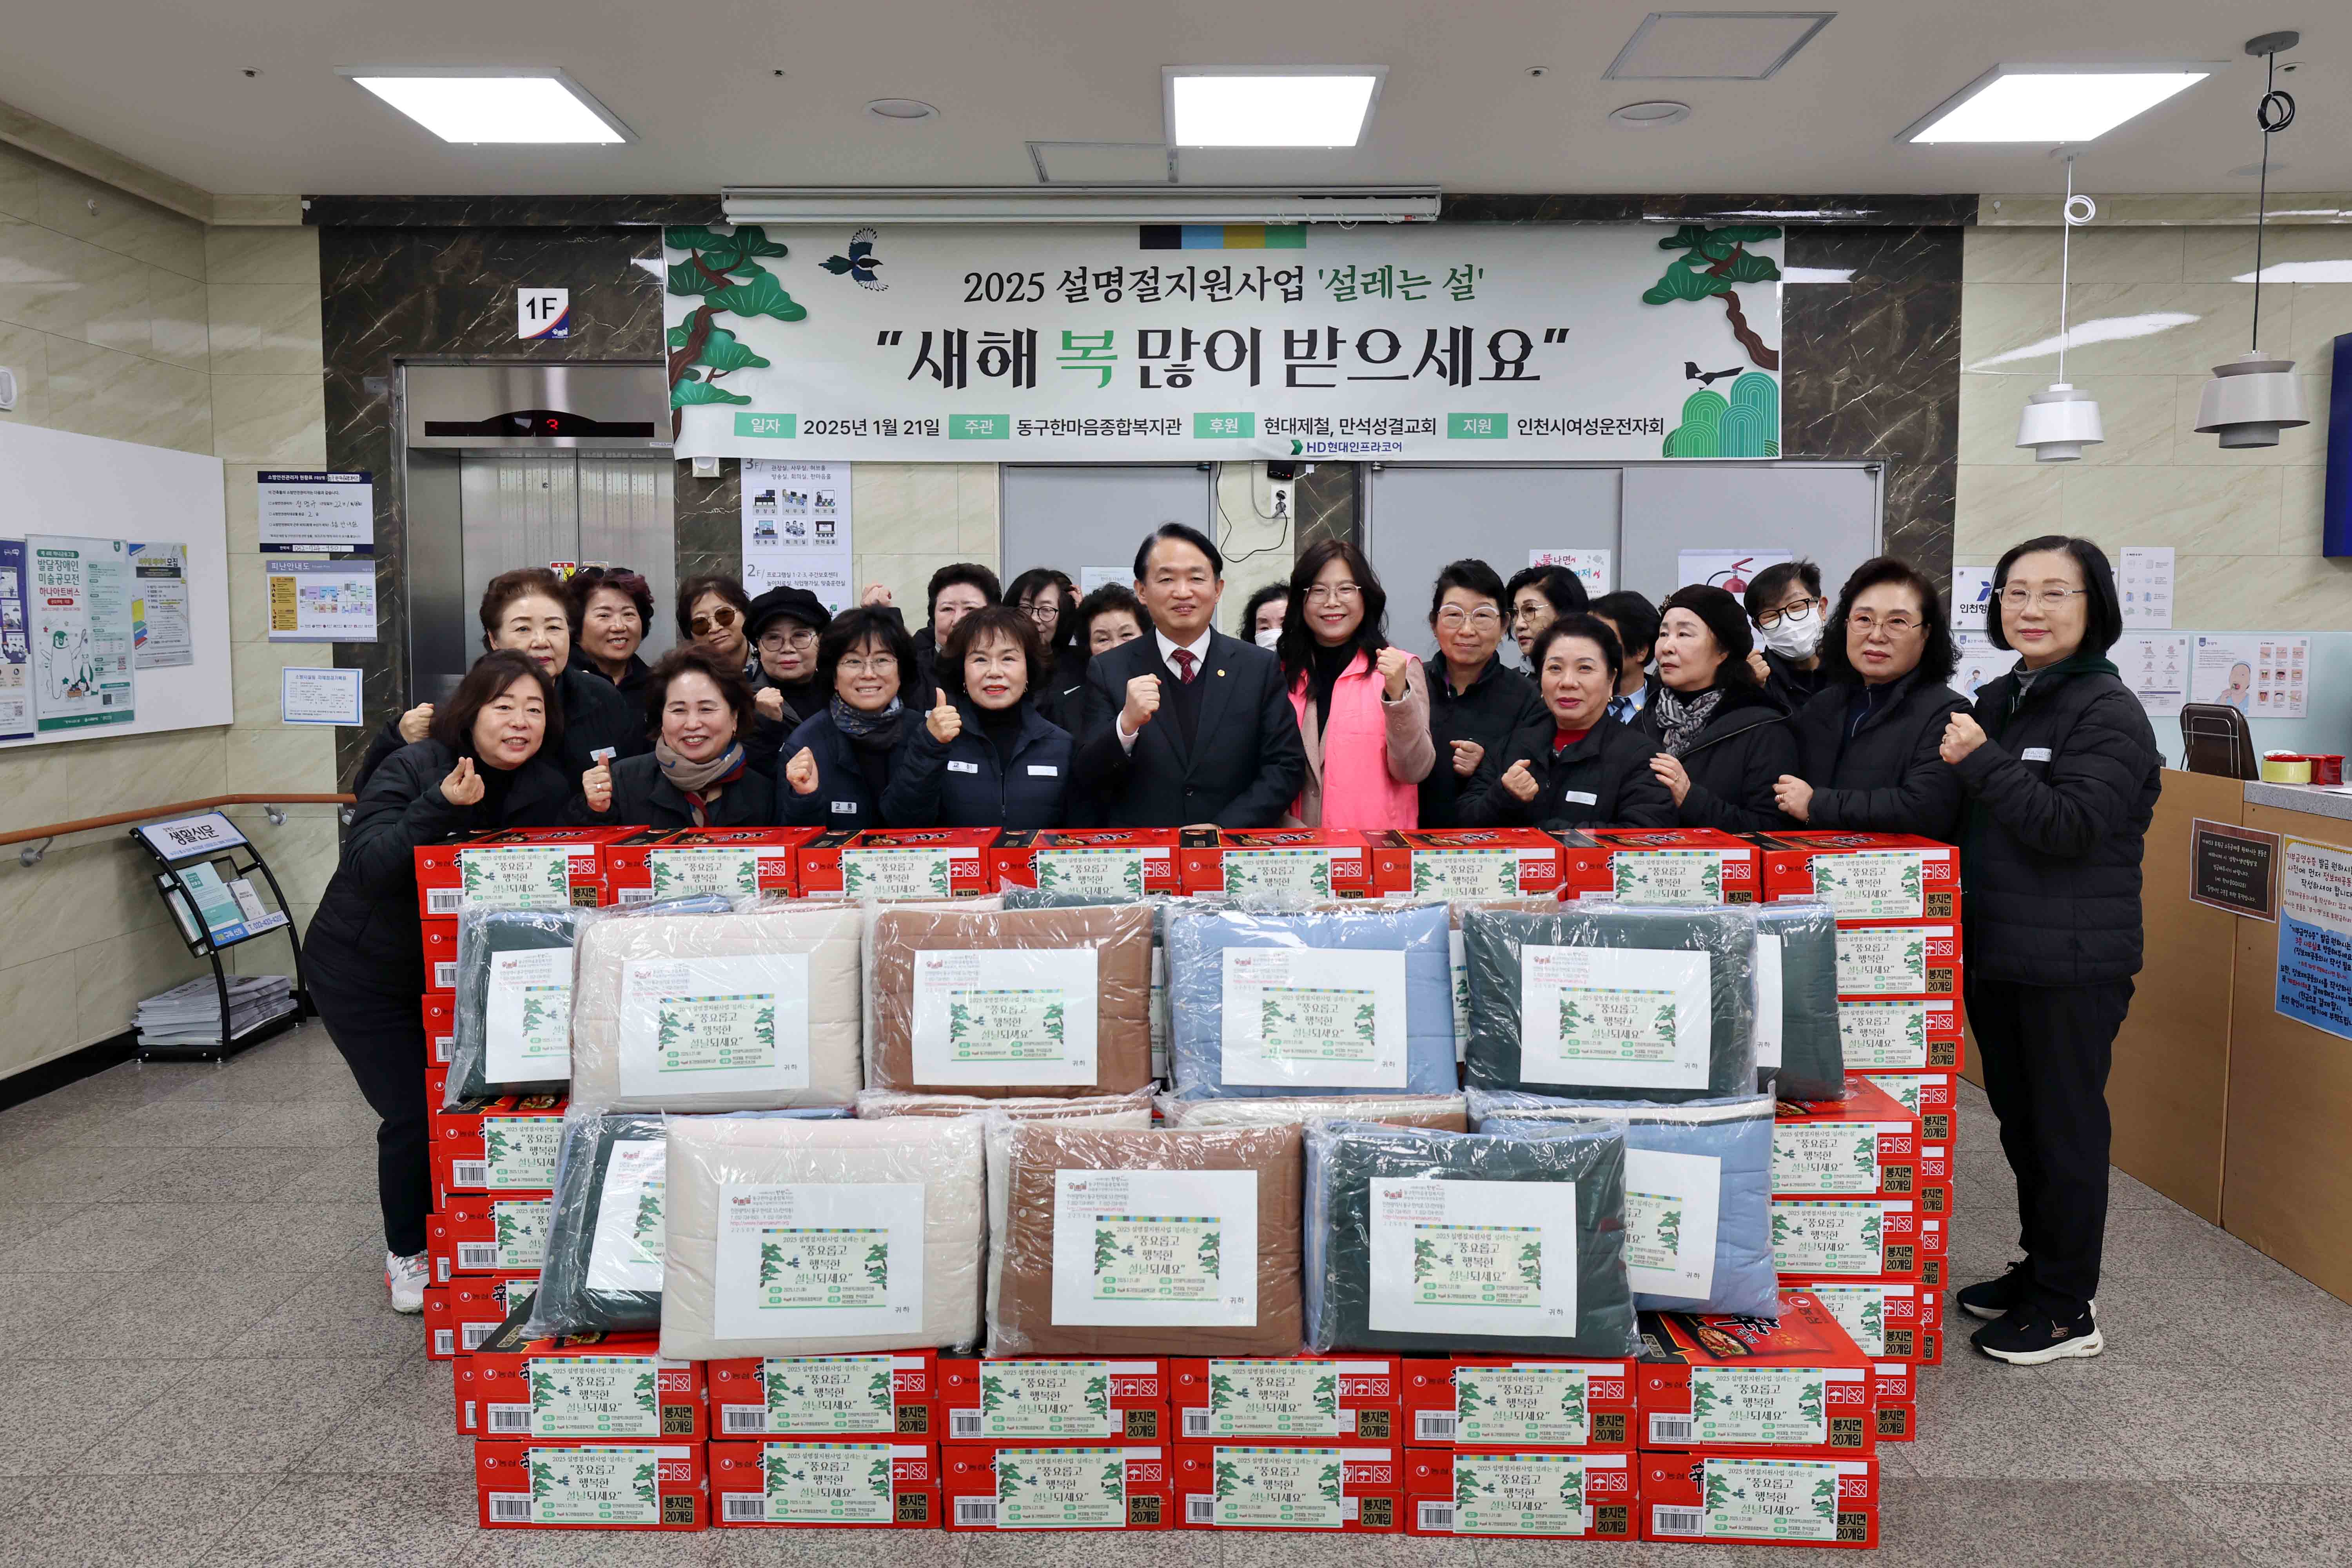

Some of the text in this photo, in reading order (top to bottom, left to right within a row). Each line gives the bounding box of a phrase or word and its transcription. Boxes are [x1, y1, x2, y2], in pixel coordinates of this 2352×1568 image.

[964, 264, 1484, 303] 2025 설명절지원사업 '설레는 설'
[526, 296, 557, 319] 1F
[877, 325, 1570, 390] "새해 복 많이 받으세요"
[751, 416, 1664, 437] 일자 2025년 1월 21일 주관 동구한마음종합복지관 후원 현대제철, 만석성결교회 지원 인천시여성운전자회
[1306, 440, 1403, 454] HD현대인프라코어
[38, 559, 79, 572] 발달장애인
[1541, 553, 1570, 566] 불나면
[271, 562, 310, 571] 피난안내도
[38, 573, 80, 585] 미술공모전
[39, 587, 81, 597] 하나아트버스
[1960, 604, 1987, 614] 인천항
[169, 825, 220, 846] 생활신문
[2286, 853, 2317, 866] 기부금영수증
[2319, 859, 2329, 869] 발급
[503, 873, 528, 882] 행복한
[2288, 865, 2305, 874] 사전에
[2309, 868, 2321, 878] 먼저
[1855, 878, 1882, 888] 행복한
[2301, 878, 2332, 892] 작성하셔야
[573, 887, 597, 898] 봉지면
[1928, 893, 1951, 904] 봉지면
[1927, 906, 1951, 916] 20개입
[2320, 934, 2330, 944] 발급
[2331, 937, 2351, 951] 원하시는
[2330, 958, 2341, 969] 작성
[1924, 1116, 1947, 1125] 봉지면
[1924, 1127, 1947, 1138] 20개입
[1804, 1151, 1832, 1161] 행복한
[1886, 1167, 1911, 1178] 봉지면
[1885, 1180, 1911, 1191] 20개입
[809, 1259, 841, 1270] 행복한
[1029, 1390, 1060, 1401] 행복한
[1128, 1411, 1156, 1423] 봉지면
[1128, 1425, 1156, 1437] 20개입
[1667, 1472, 1685, 1480] 농심
[579, 1477, 610, 1489] 행복한
[1746, 1477, 1794, 1489] "풍요롭고
[665, 1497, 693, 1508] 봉지면
[1755, 1491, 1787, 1503] 행복한
[665, 1511, 693, 1523] 20개입
[1838, 1514, 1866, 1526] 봉지면
[1837, 1528, 1866, 1540] 20개입
